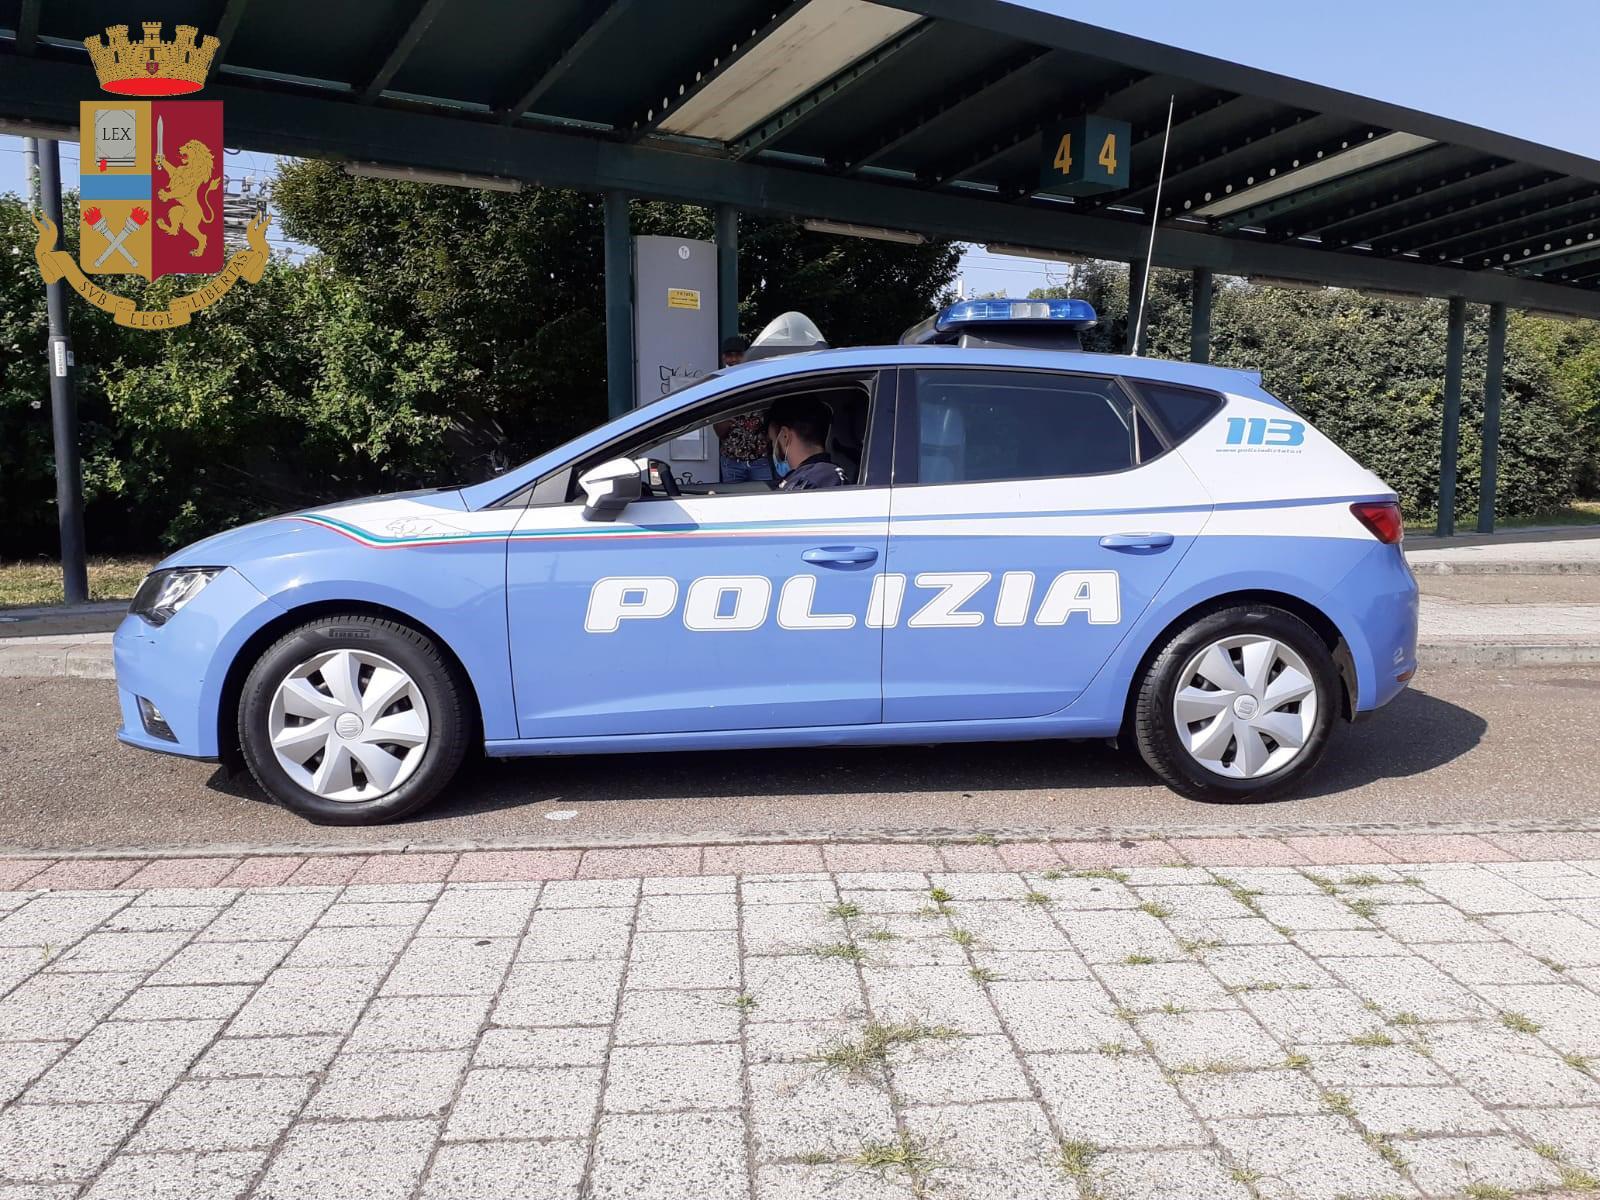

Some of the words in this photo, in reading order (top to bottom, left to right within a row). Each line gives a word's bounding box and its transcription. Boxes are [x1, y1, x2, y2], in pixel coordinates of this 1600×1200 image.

[1053, 133, 1072, 174] 4
[1098, 133, 1117, 174] 4
[1226, 417, 1305, 446] 113
[584, 570, 1121, 633] POLIZIA
